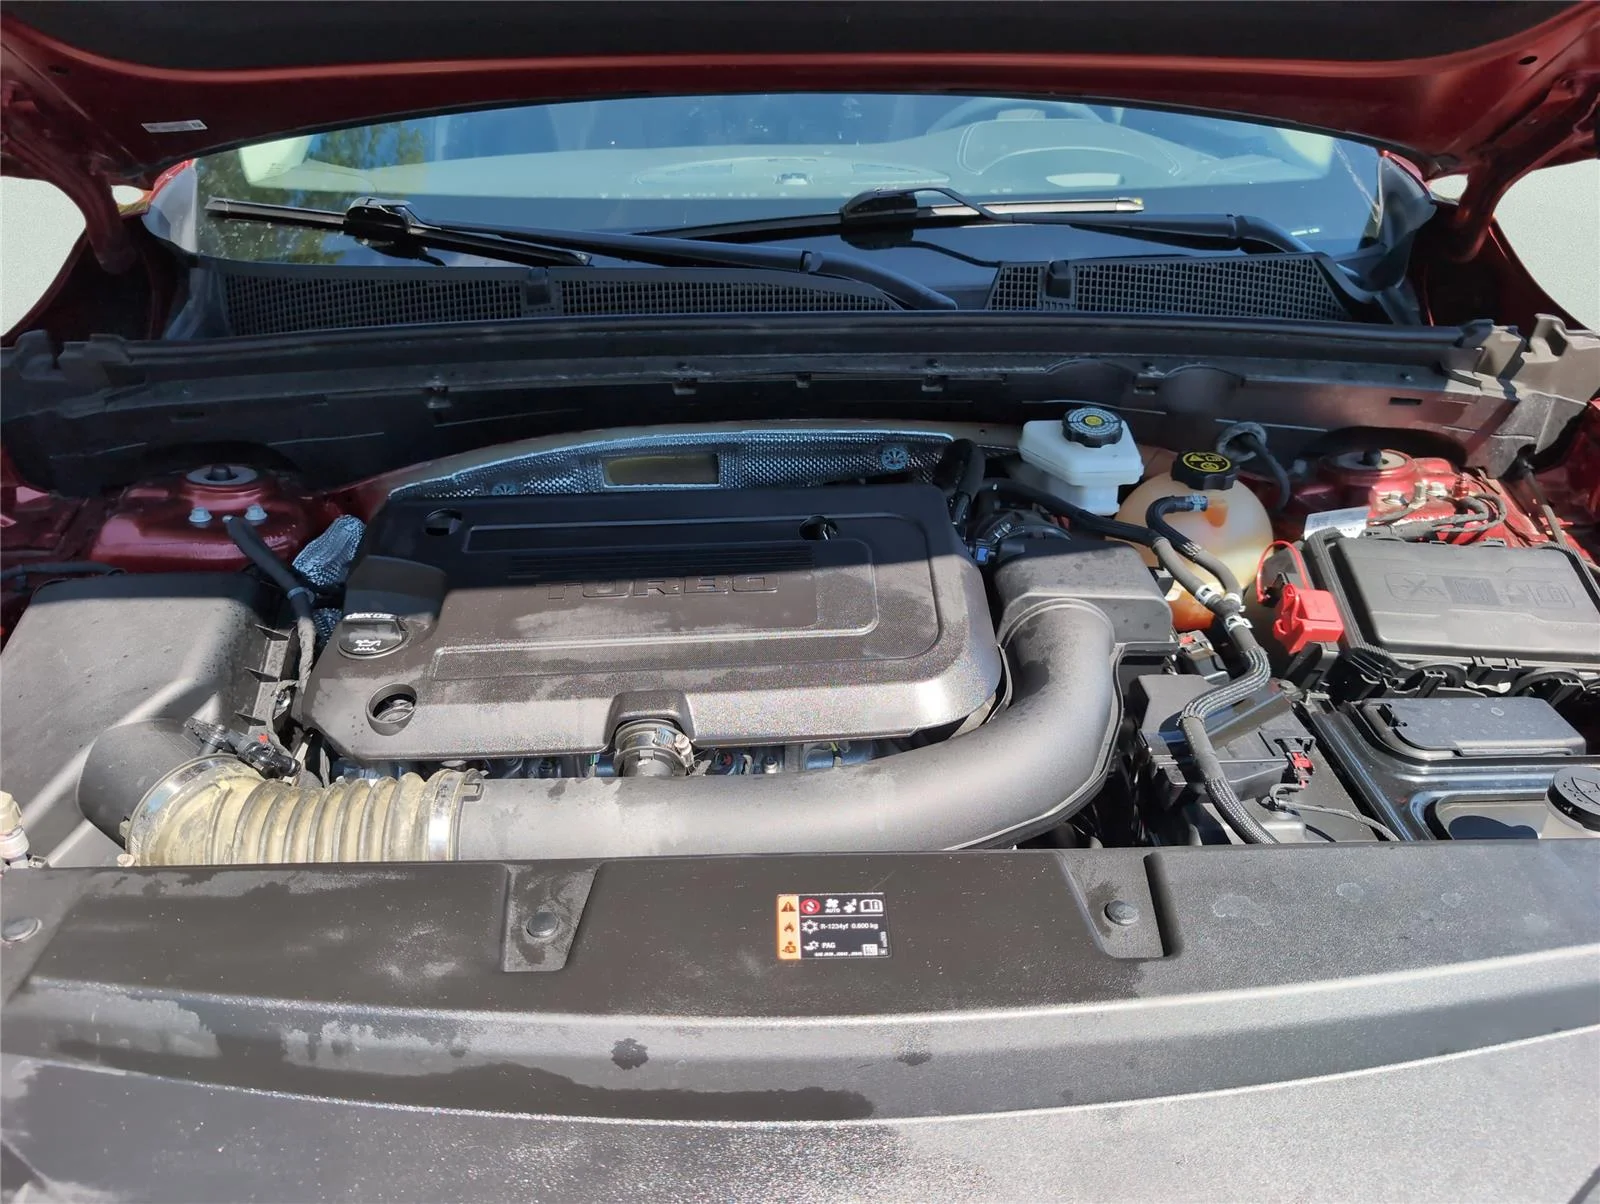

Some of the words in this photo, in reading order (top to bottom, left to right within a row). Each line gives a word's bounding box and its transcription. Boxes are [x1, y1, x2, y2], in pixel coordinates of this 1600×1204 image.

[534, 574, 779, 600] TURBO
[820, 922, 849, 931] R-1234yf
[870, 922, 879, 930] kg
